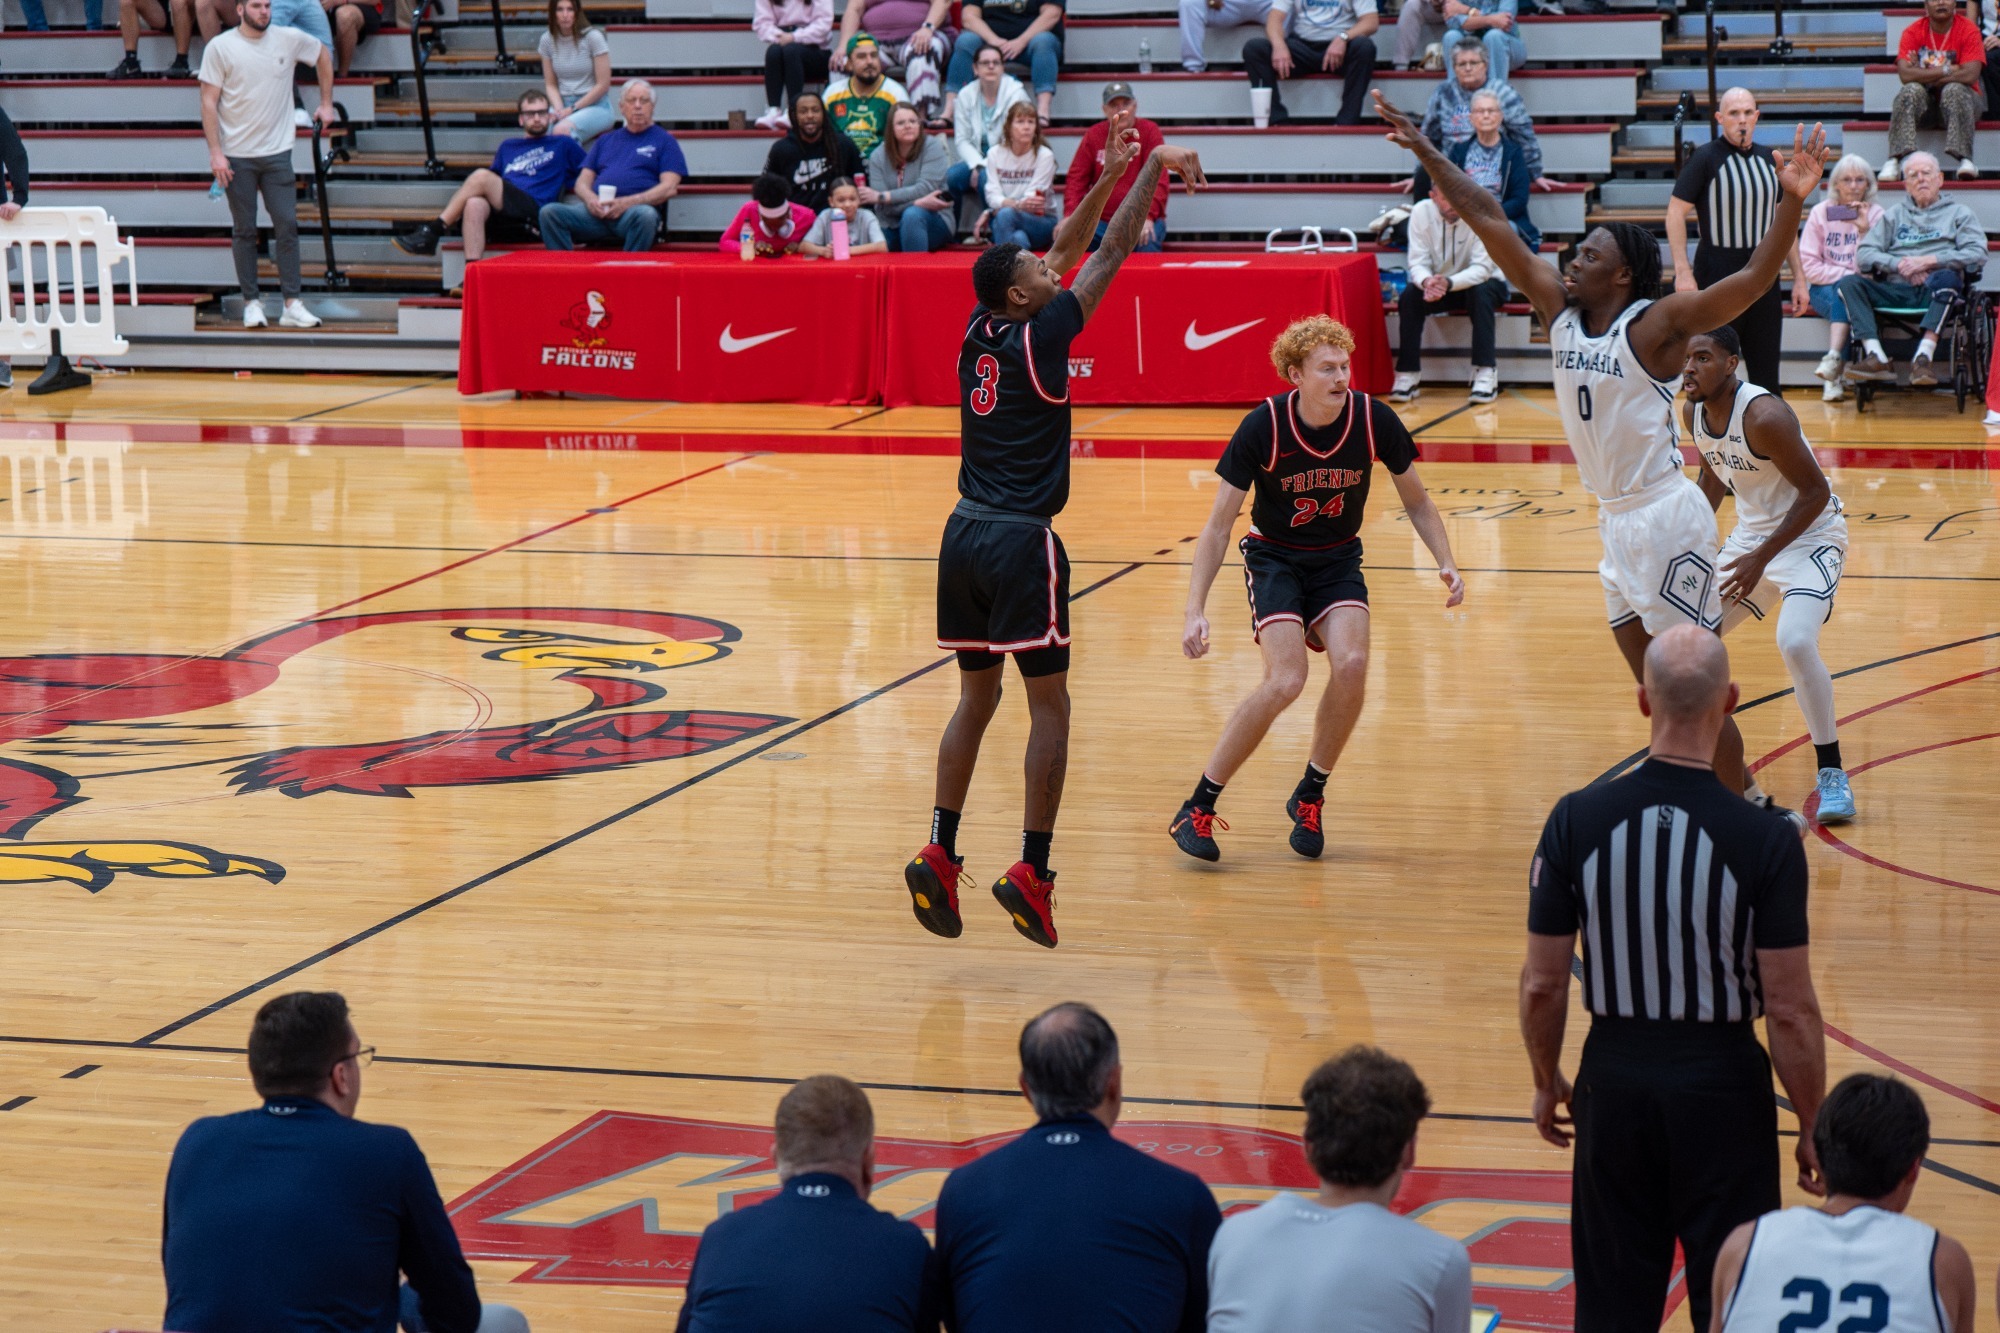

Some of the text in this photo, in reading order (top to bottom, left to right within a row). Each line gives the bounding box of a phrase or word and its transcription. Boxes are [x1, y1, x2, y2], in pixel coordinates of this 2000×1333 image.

[541, 347, 636, 370] FALCONS
[970, 353, 1001, 416] 3
[1577, 384, 1593, 421] 0
[1280, 468, 1363, 493] FRIENDS
[1290, 491, 1346, 528] 24
[1778, 1276, 1890, 1333] 22
